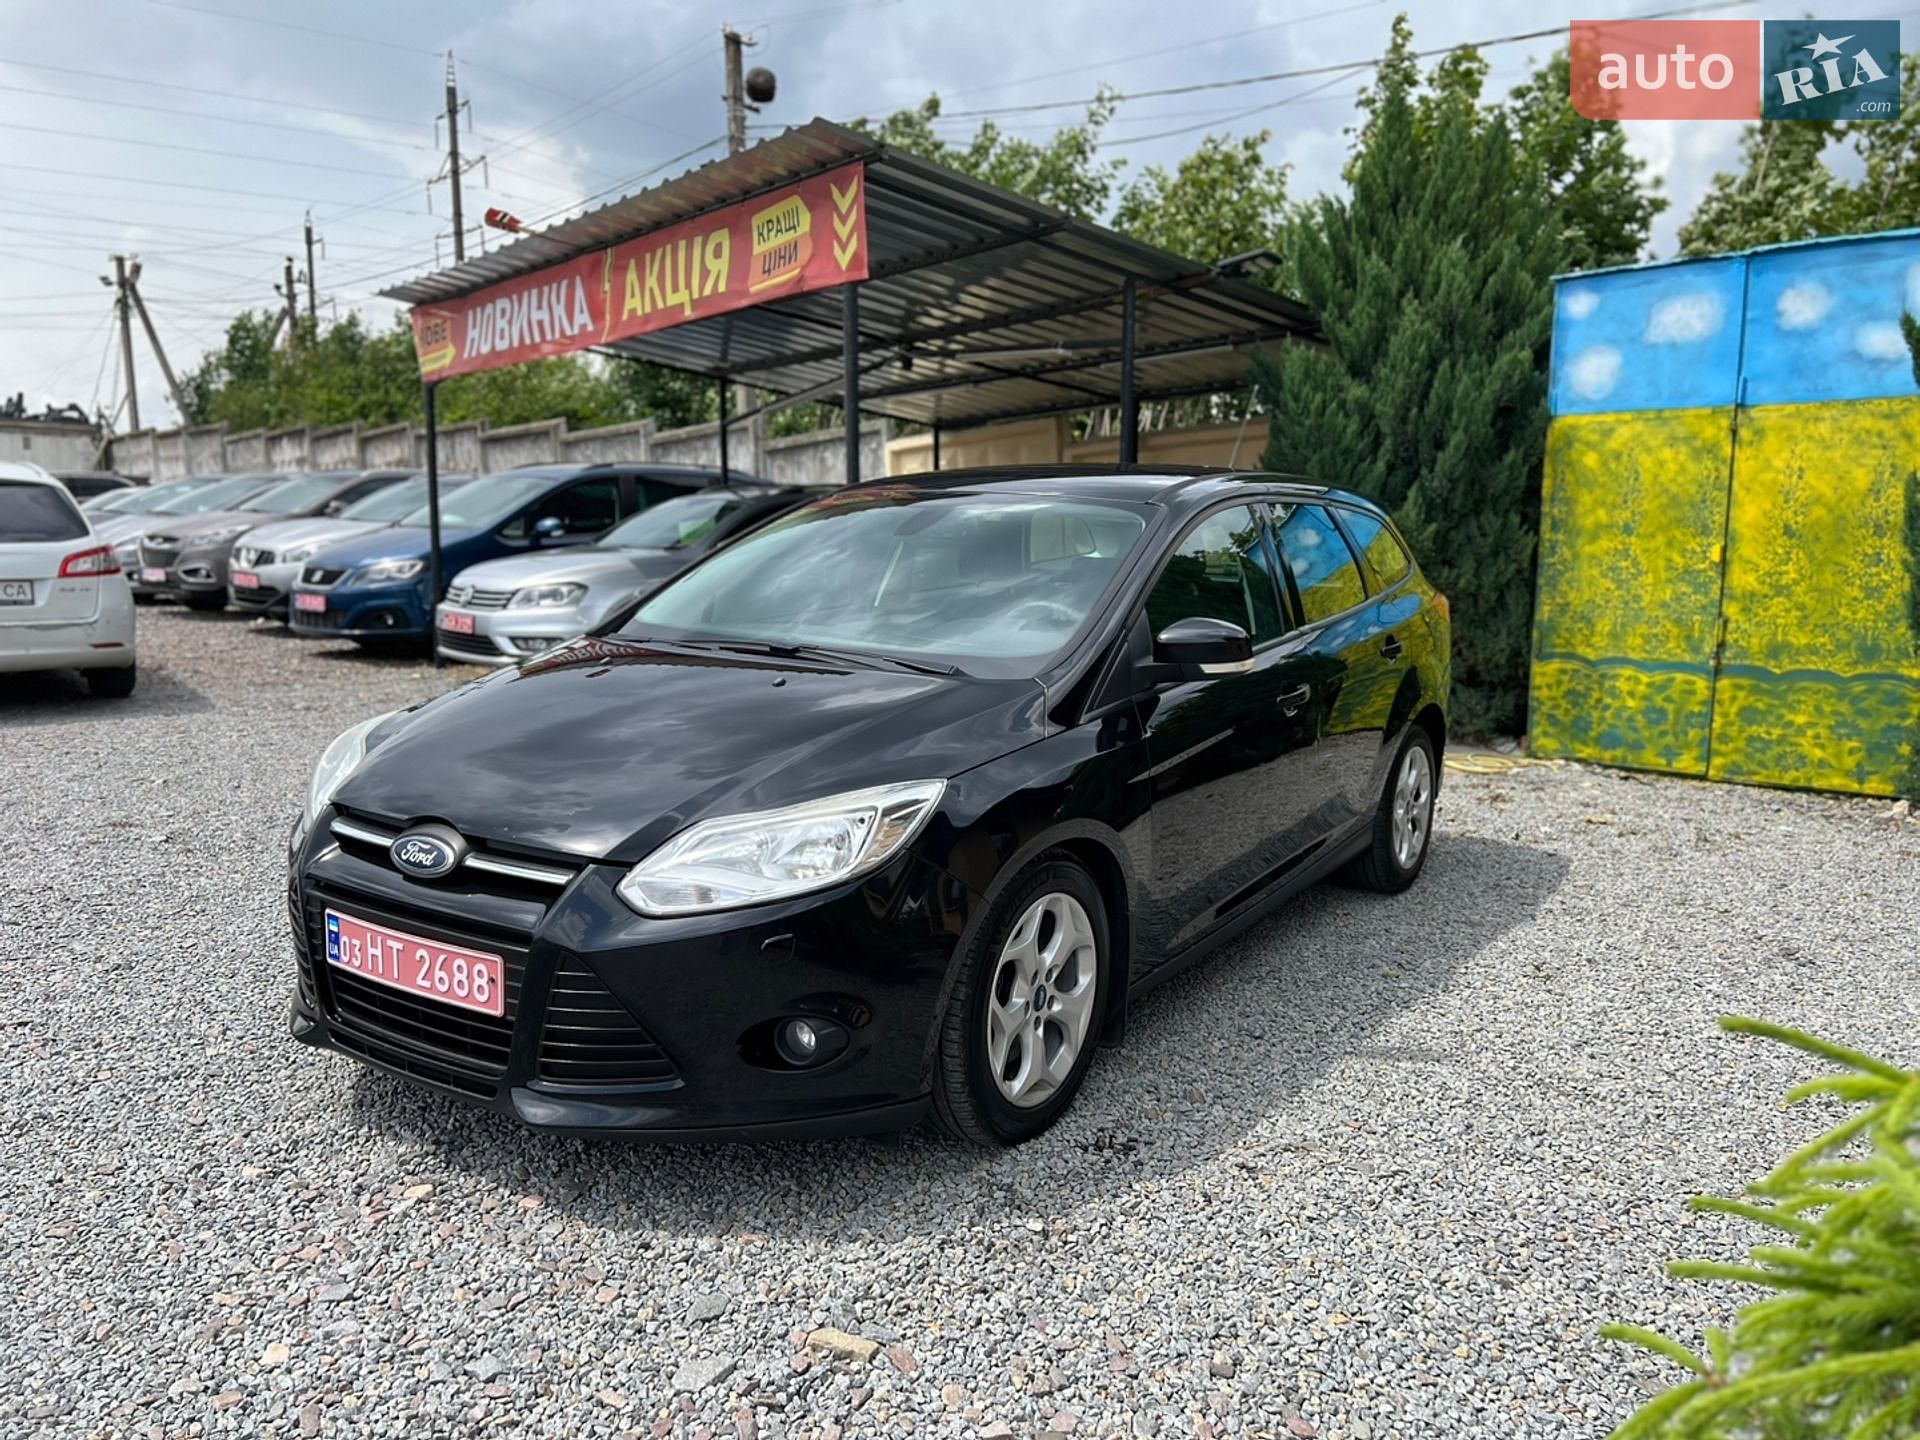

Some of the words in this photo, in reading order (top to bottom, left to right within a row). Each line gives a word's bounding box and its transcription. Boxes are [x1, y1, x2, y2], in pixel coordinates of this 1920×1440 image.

[756, 205, 800, 245] КРАЩІ
[622, 228, 731, 321] АКЦІЯ
[761, 243, 799, 277] ЦІНИ
[463, 276, 594, 360] НОВИНКА
[401, 840, 437, 866] Ford
[330, 946, 339, 956] UA
[415, 948, 490, 1003] 2688
